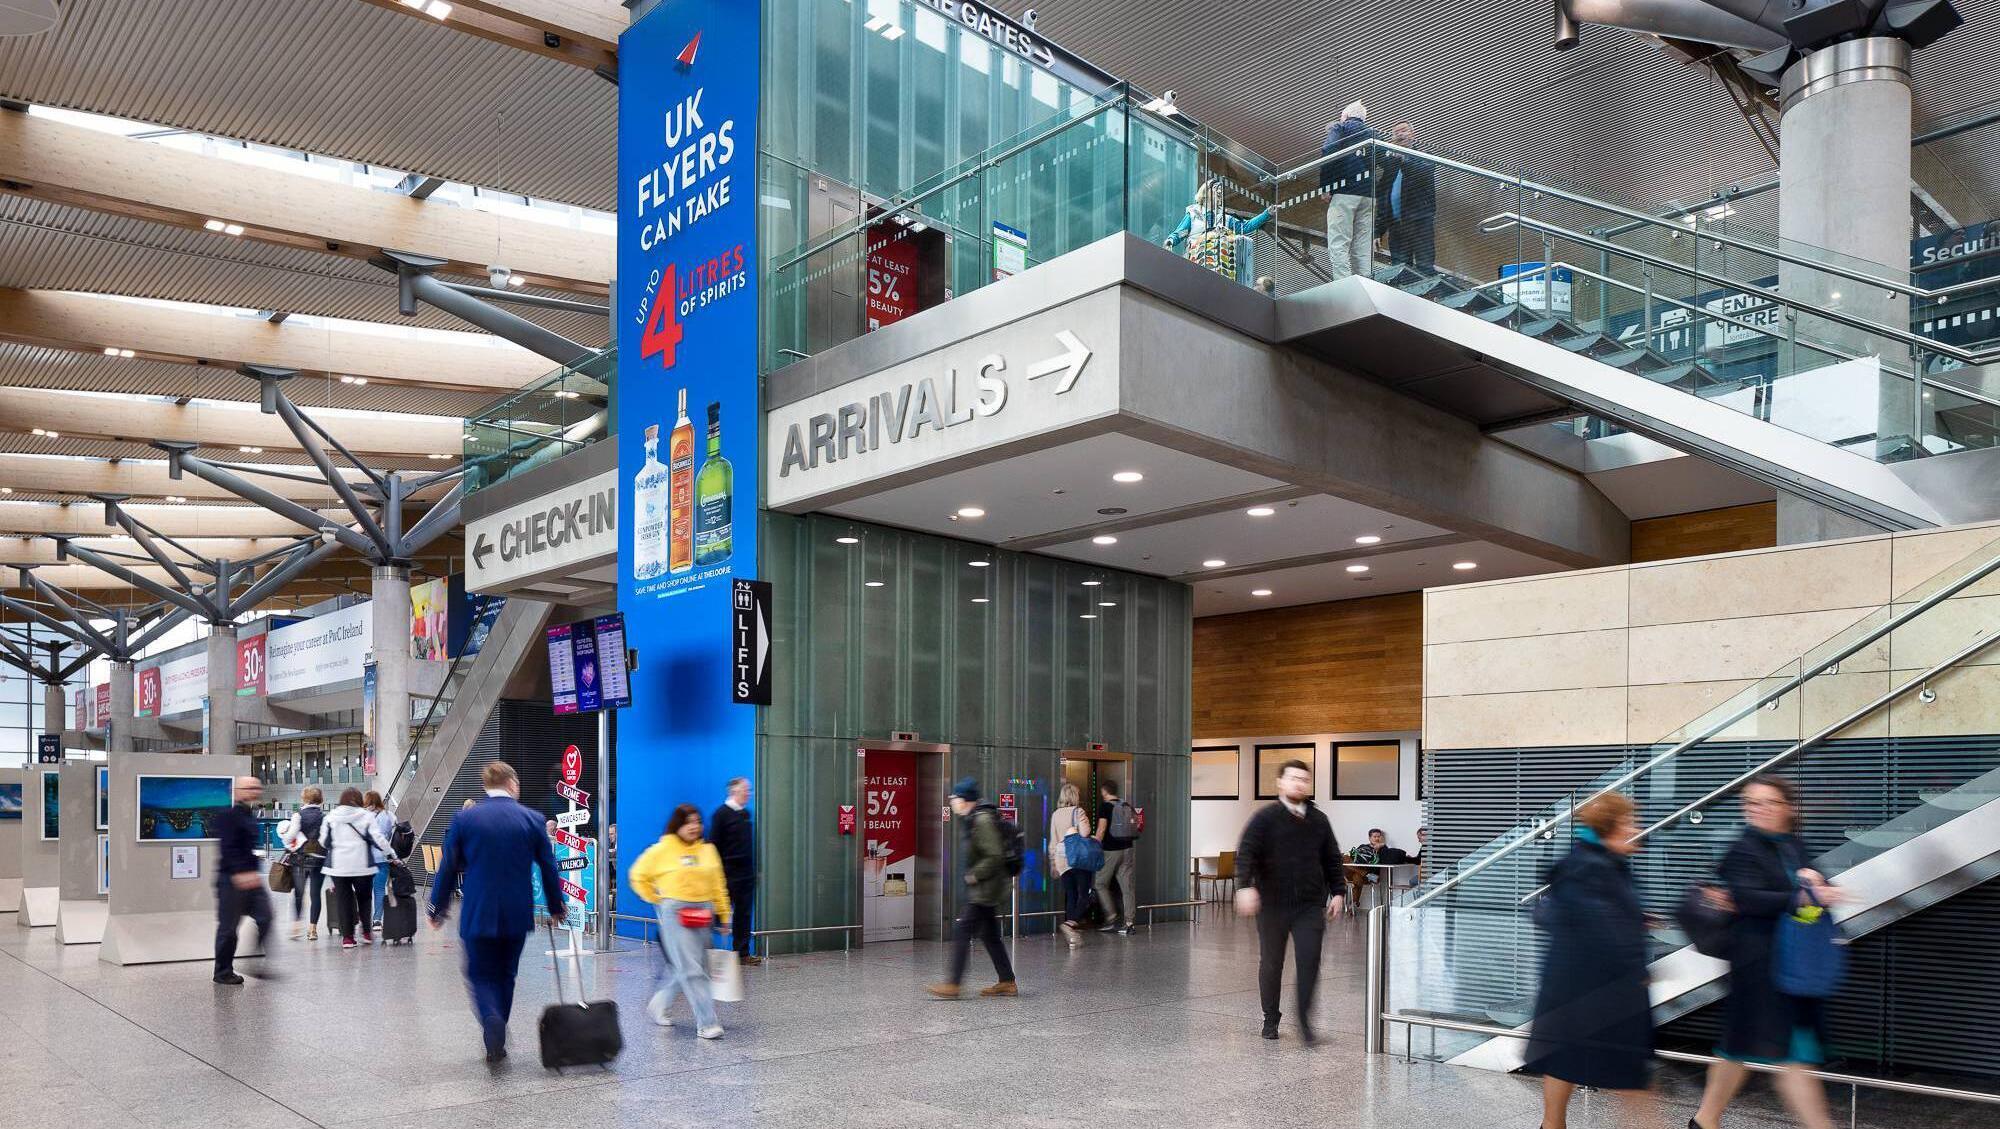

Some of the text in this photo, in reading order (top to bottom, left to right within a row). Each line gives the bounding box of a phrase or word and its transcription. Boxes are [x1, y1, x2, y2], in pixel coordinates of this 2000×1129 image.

[961, 2, 1032, 58] GATES
[665, 87, 704, 148] UK
[638, 119, 735, 217] FLYERS
[641, 175, 731, 251] CAN TAKE
[678, 244, 744, 300] LITRES
[871, 255, 882, 265] AT
[884, 259, 910, 275] LEAST
[635, 268, 660, 325] UP TO
[680, 271, 746, 317] OF SPIRITS
[869, 268, 900, 302] 5%
[641, 262, 683, 369] 4
[870, 298, 904, 316] BEAUTY
[779, 353, 1009, 478] ARRIVALS
[500, 487, 616, 563] CHECK-IN
[635, 587, 647, 596] SAVE
[646, 585, 656, 594] TIME
[656, 582, 667, 590] AND
[667, 579, 680, 588] SHOP
[679, 574, 697, 584] ONLINE
[294, 641, 305, 656] your
[305, 636, 322, 649] career
[322, 633, 328, 645] at
[328, 626, 342, 643] PwC
[342, 619, 363, 640] Ireland
[244, 647, 264, 682] 30%
[737, 613, 749, 698] LIFTS
[563, 785, 580, 802] ROME
[870, 776, 881, 785] AT
[883, 776, 908, 786] LEAST
[560, 812, 587, 824] NEWCASTLE
[867, 790, 898, 816] 5%
[564, 834, 580, 849] FARO
[868, 820, 902, 829] BEAUTY
[561, 859, 585, 870] VALENCIA
[563, 881, 580, 898] PARIS
